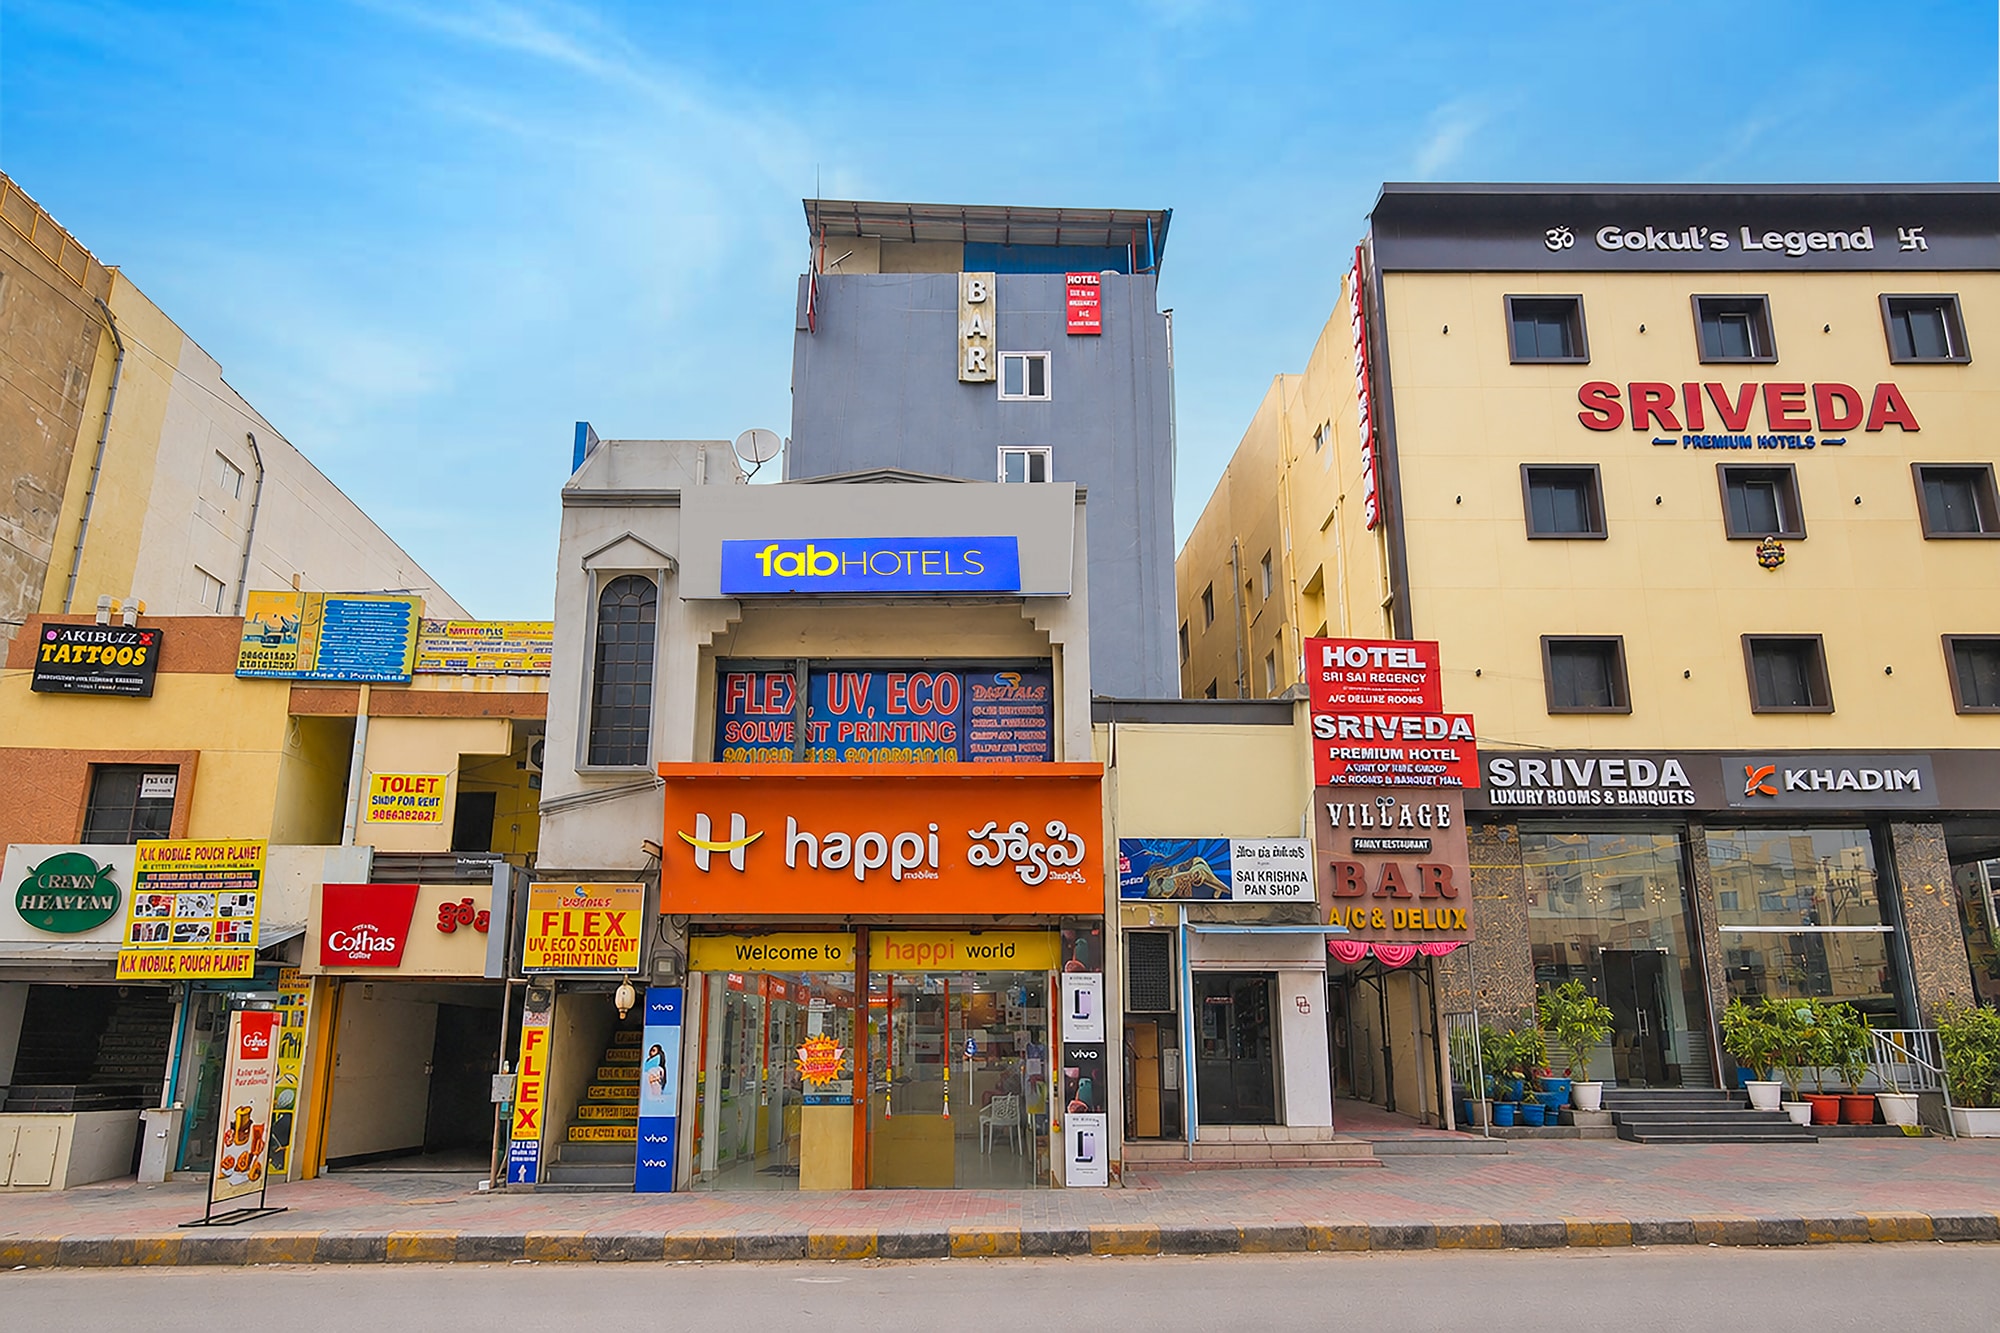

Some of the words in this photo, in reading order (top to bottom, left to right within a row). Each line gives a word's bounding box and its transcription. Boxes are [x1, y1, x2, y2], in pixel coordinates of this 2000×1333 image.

[1596, 227, 1730, 251] Gokul's
[1740, 226, 1874, 255] Legend
[1067, 275, 1100, 284] HOTEL
[967, 280, 988, 373] BAR
[1578, 381, 1920, 432] SRIVEDA
[1683, 435, 1752, 449] PREMIUM
[1757, 435, 1816, 449] HOTELS
[41, 644, 148, 666] TATTOOS
[1323, 646, 1427, 668] HOTEL
[1322, 672, 1343, 682] SRI
[1346, 672, 1366, 683] SAI
[1370, 673, 1427, 684] REGENCY
[887, 672, 961, 716] ECO
[1328, 694, 1346, 703] A/C
[1348, 694, 1385, 704] DELUXE
[1387, 695, 1424, 704] ROOMS
[838, 721, 957, 744] PRINTING
[1313, 714, 1475, 741] SRIVEDA
[1329, 747, 1404, 760] PREMIUM
[1409, 749, 1461, 761] HOTEL
[1488, 758, 1691, 787] SRIVEDA
[1784, 769, 1922, 792] KHADIM
[380, 776, 439, 793] TOLET
[397, 795, 415, 806] FOR
[418, 796, 440, 807] RENT
[1490, 788, 1543, 805] LUXURY
[1547, 788, 1600, 805] ROOMS
[1603, 789, 1615, 804] &
[1617, 789, 1696, 806] BANQUETS
[1326, 800, 1451, 828] VILLAGE
[194, 847, 225, 860] POUCH
[227, 846, 261, 860] PLANET
[785, 816, 939, 882] happi
[1236, 870, 1255, 882] SAI
[1258, 870, 1308, 883] KRISHNA
[1331, 861, 1458, 899] BAR
[1244, 884, 1267, 896] PAN
[1270, 884, 1300, 896] SHOP
[541, 912, 627, 936] FLEX
[1329, 906, 1367, 930] A/C
[1371, 907, 1387, 929] &
[1393, 908, 1468, 930] DELUX
[580, 938, 637, 952] SOLVENT
[736, 945, 818, 960] Welcome
[825, 944, 841, 960] to
[885, 936, 954, 966] happi
[966, 943, 1016, 958] world
[179, 955, 210, 972] POUCH
[213, 954, 250, 972] PLANET
[543, 953, 619, 966] PRINTING
[1071, 1050, 1098, 1059] vivo
[516, 1030, 544, 1129] FLEX
[644, 1133, 668, 1143] vivo
[643, 1158, 667, 1168] vivo
